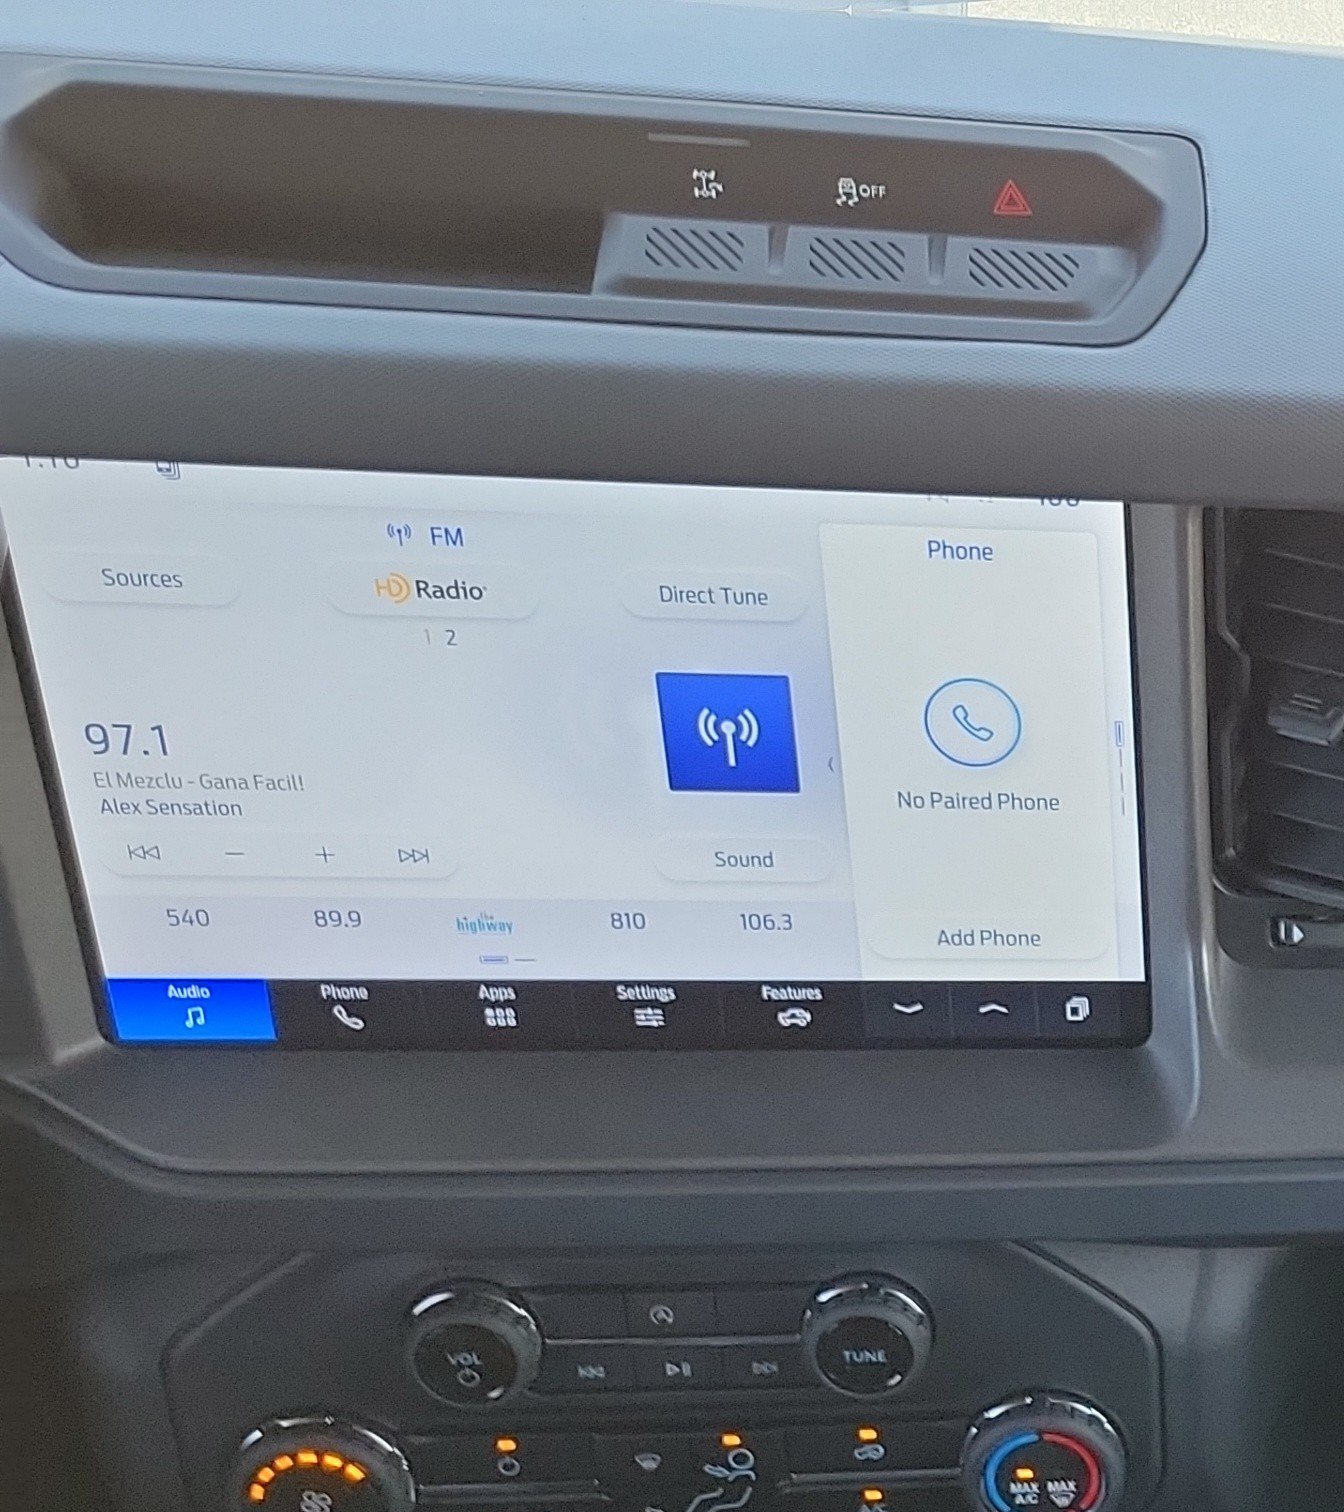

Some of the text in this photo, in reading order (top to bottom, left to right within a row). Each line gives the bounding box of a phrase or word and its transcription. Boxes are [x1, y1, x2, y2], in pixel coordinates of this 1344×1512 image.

[859, 185, 886, 199] OFF
[430, 527, 465, 548] FM
[926, 540, 995, 563] Phone
[101, 567, 183, 590] Sources
[659, 584, 769, 607] Direct Tune
[445, 629, 458, 646] 2
[84, 722, 171, 757] 97.1
[94, 771, 112, 789] El
[116, 771, 184, 790] Mezclu
[199, 773, 249, 791] Gana
[253, 774, 305, 792] Facil!
[101, 798, 243, 817] Alex Sensation
[897, 790, 1061, 812] No Paired Phone
[714, 849, 775, 869] Sound
[165, 908, 210, 929] 540
[313, 909, 362, 930] 89.9
[456, 916, 514, 935] highway
[610, 912, 647, 931] 810
[739, 912, 794, 932] 106.3
[937, 928, 1043, 949] Add Phone
[167, 983, 210, 1001] Audio
[319, 983, 370, 1002] Phone
[477, 984, 517, 1004] Apps
[616, 984, 677, 1004] Settings
[761, 984, 823, 1002] Features
[448, 1351, 483, 1367] VOL
[843, 1350, 888, 1364] TUNE
[1009, 1481, 1040, 1494] MAX
[1046, 1480, 1077, 1493] MAX
